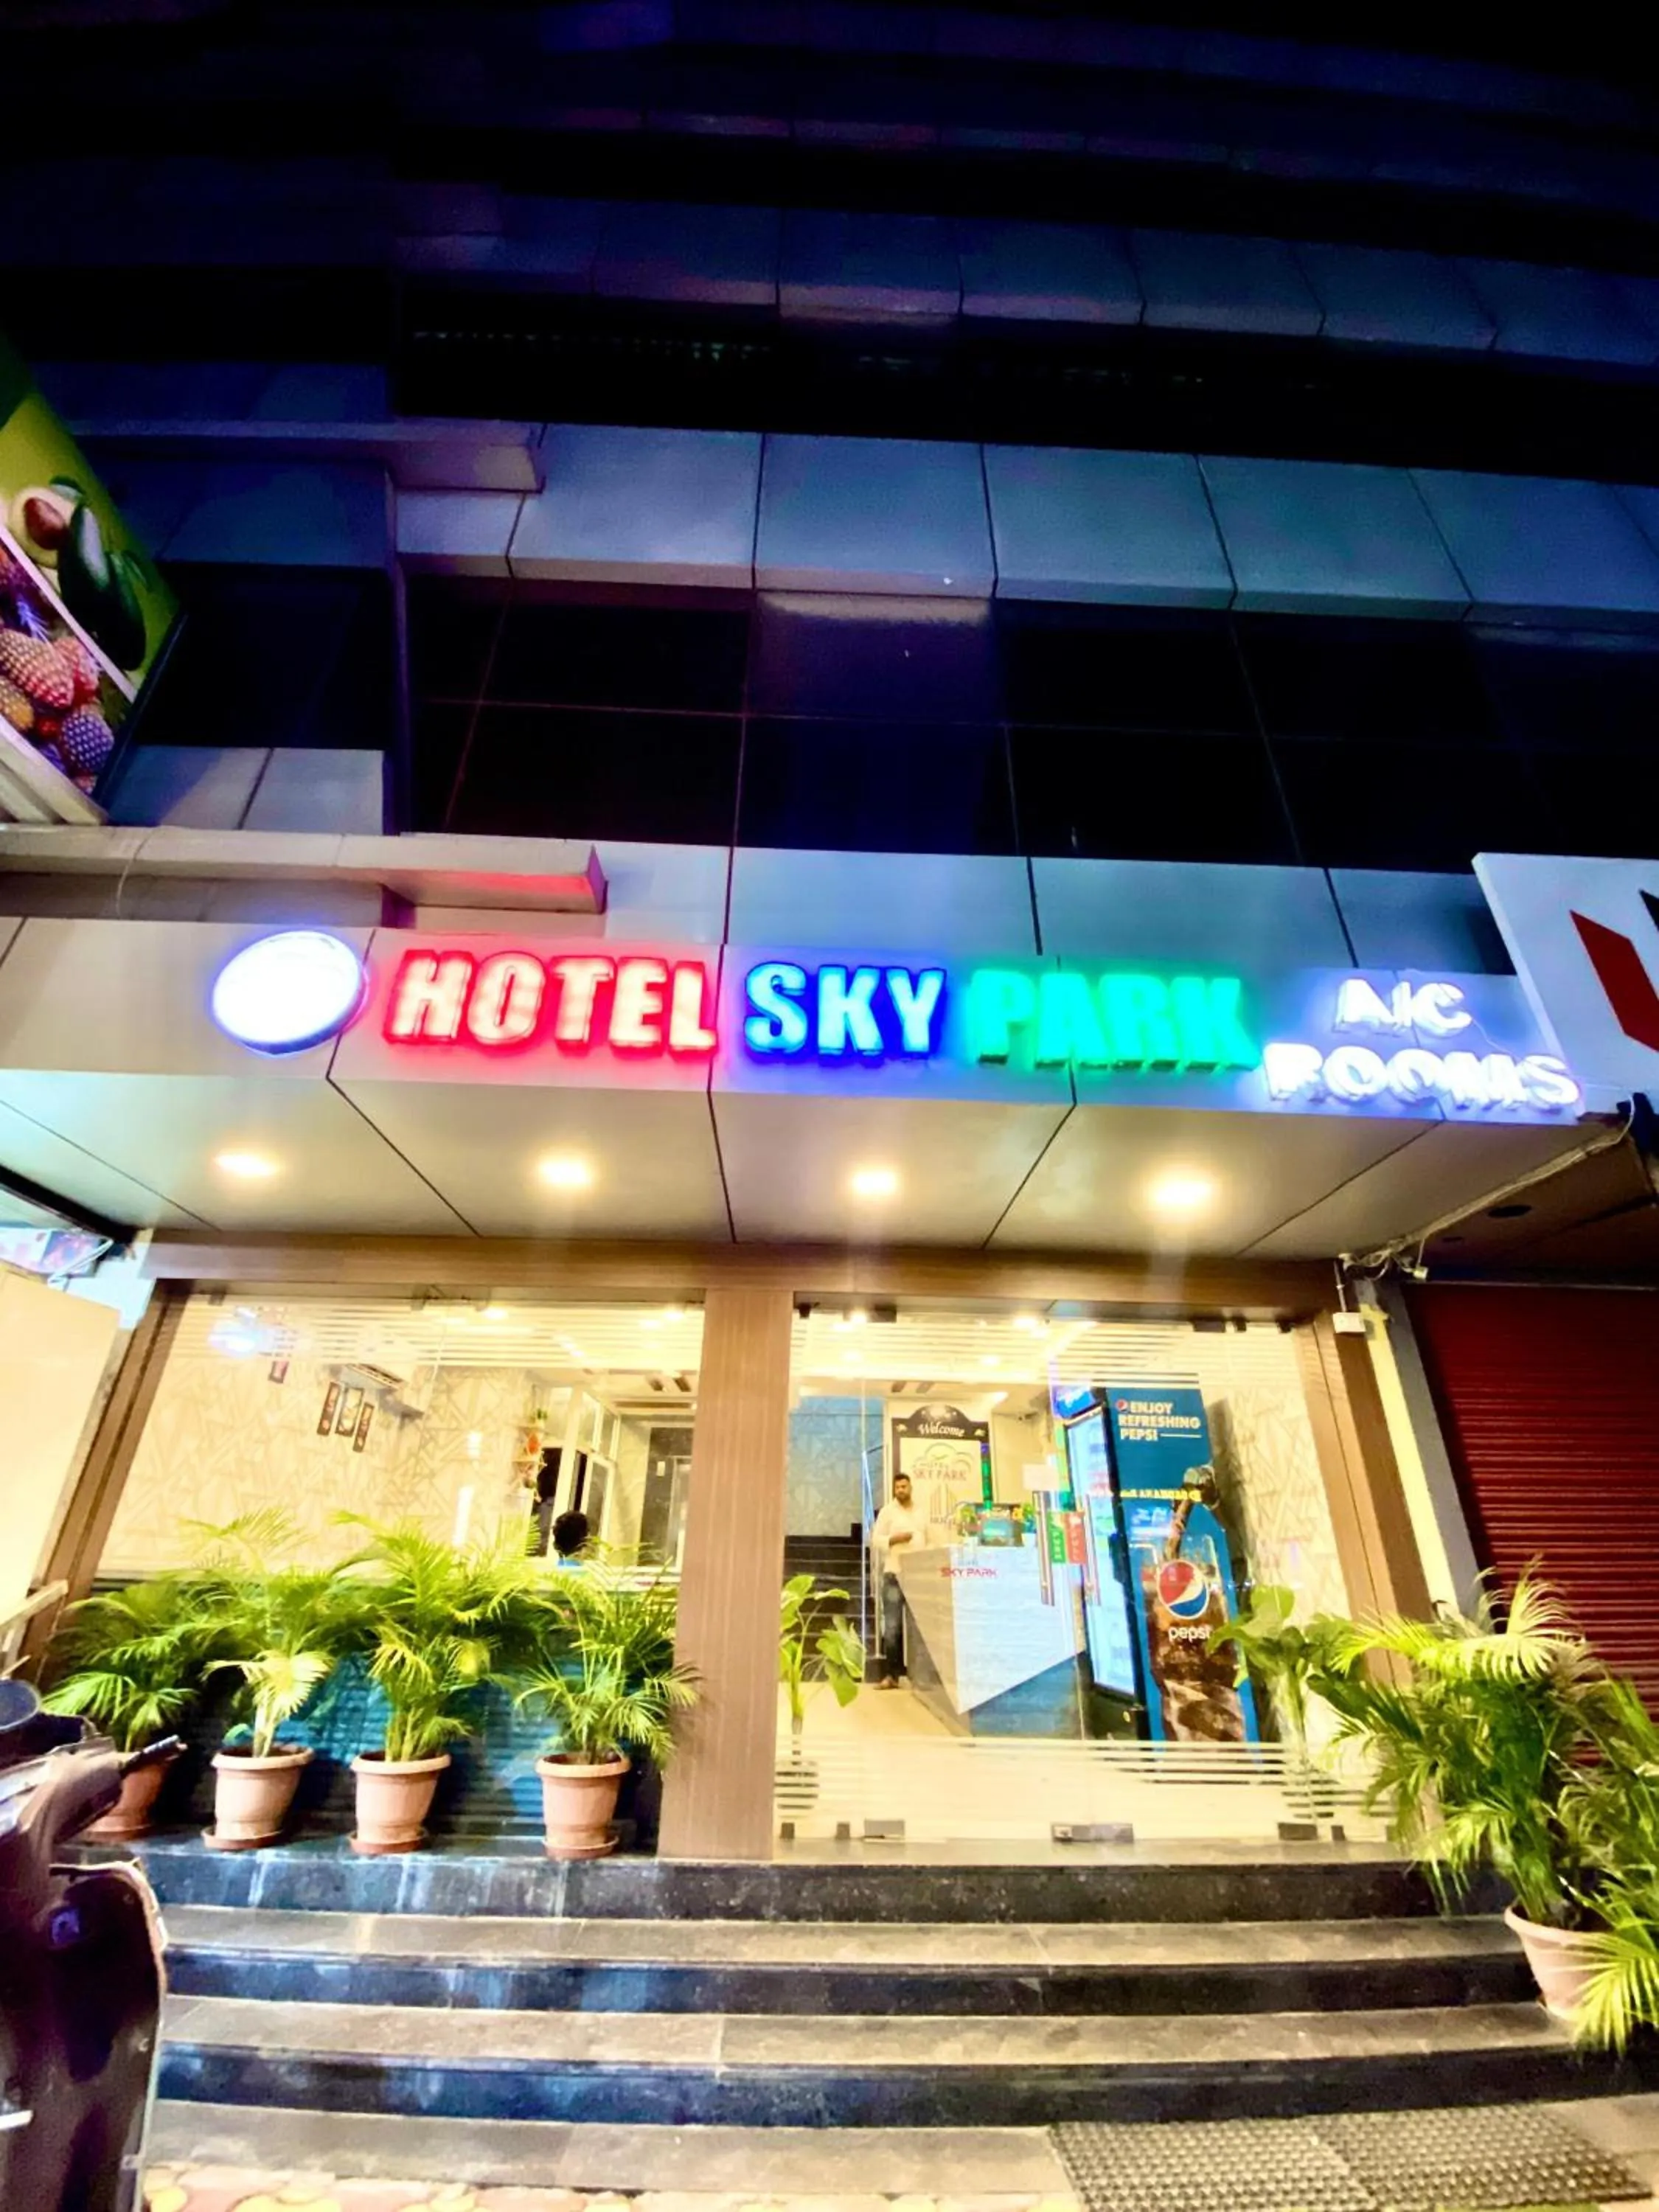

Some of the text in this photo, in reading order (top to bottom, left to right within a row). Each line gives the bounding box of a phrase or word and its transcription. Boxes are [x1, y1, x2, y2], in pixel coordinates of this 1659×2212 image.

[385, 949, 1259, 1071] HOTEL SKY PARK
[1262, 1043, 1582, 1109] ROOMS
[1130, 1401, 1173, 1414] ENJOY
[917, 1420, 965, 1437] Welcome
[1118, 1413, 1201, 1429] REFRESHING
[1120, 1427, 1158, 1441] PEPSI
[966, 1568, 997, 1578] PARK
[1168, 1624, 1213, 1643] pepsi
